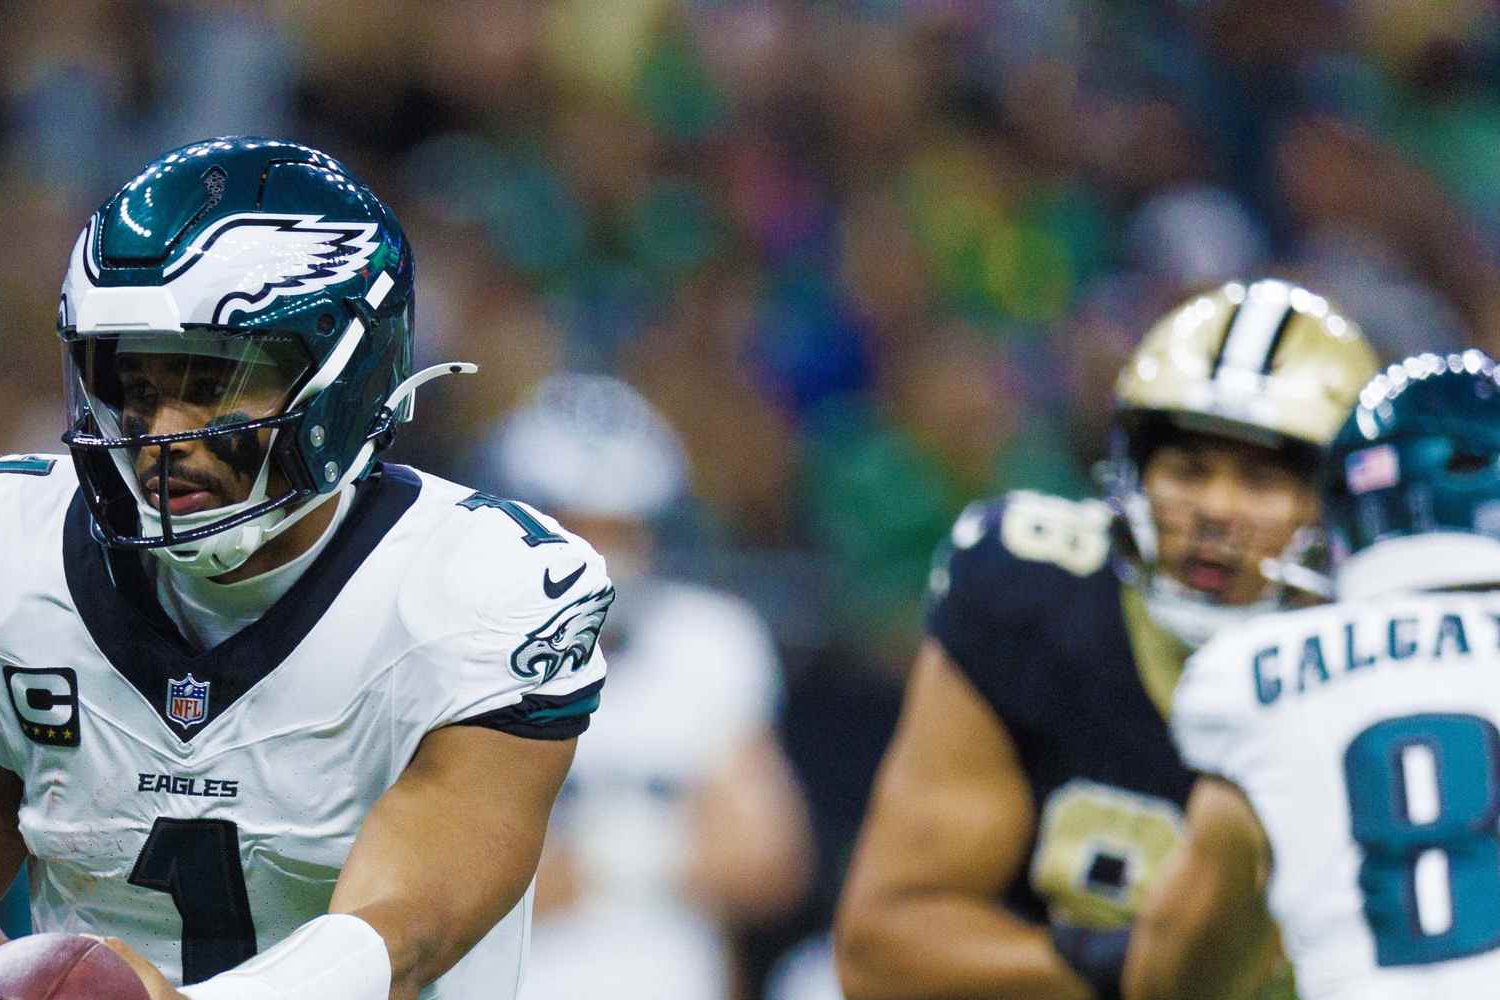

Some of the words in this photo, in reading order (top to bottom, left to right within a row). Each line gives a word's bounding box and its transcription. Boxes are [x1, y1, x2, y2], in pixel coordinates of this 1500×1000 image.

[454, 490, 569, 548] 1
[10, 672, 73, 726] C
[172, 698, 202, 720] NFL
[137, 772, 240, 798] EAGLES
[127, 815, 258, 987] 1
